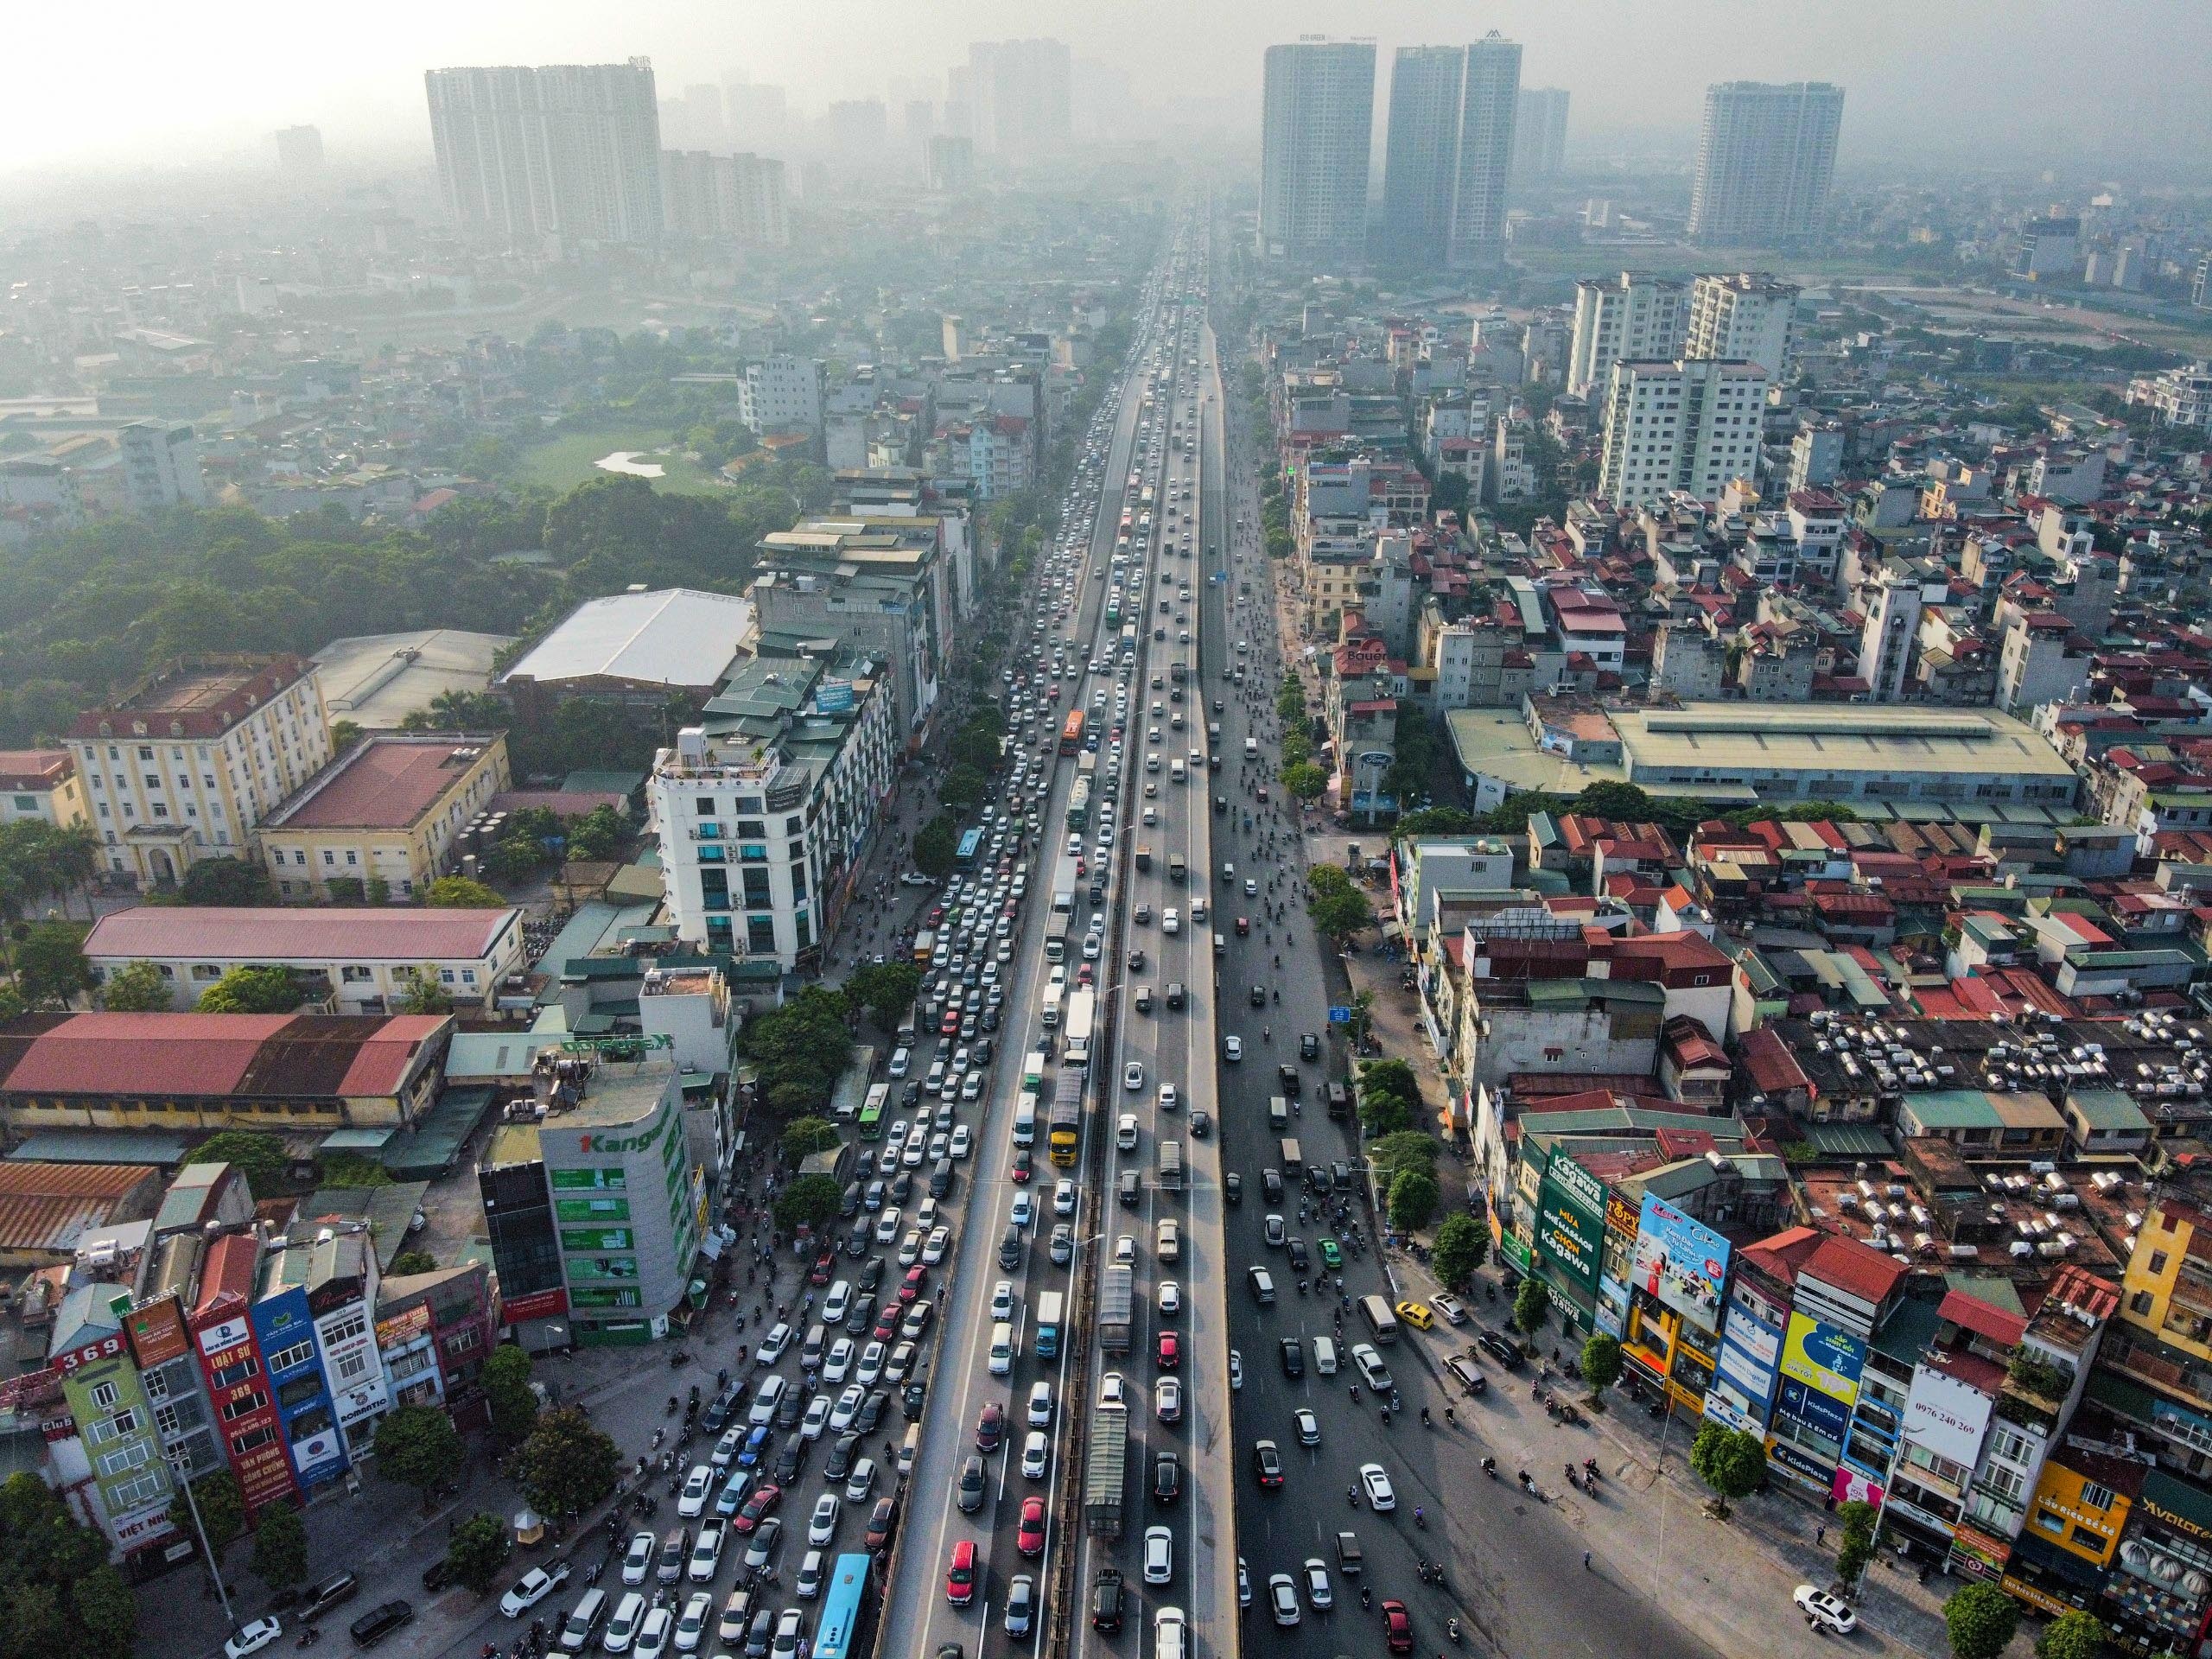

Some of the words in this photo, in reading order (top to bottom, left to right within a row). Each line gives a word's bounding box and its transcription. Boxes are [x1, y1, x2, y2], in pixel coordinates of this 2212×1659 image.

[1366, 754, 1389, 766] Ford
[1554, 1154, 1601, 1202] Kagawa
[1559, 1207, 1579, 1230] MUA
[1541, 1228, 1590, 1276] Kagawa
[1558, 1221, 1593, 1253] MASSAGE
[62, 1338, 118, 1370] 369
[1807, 1400, 1843, 1422] KidsPlaza
[1916, 1402, 1937, 1418] 0976
[1938, 1413, 1956, 1427] 240
[1957, 1421, 1975, 1434] 269
[1787, 1455, 1828, 1482] KidsPlaza
